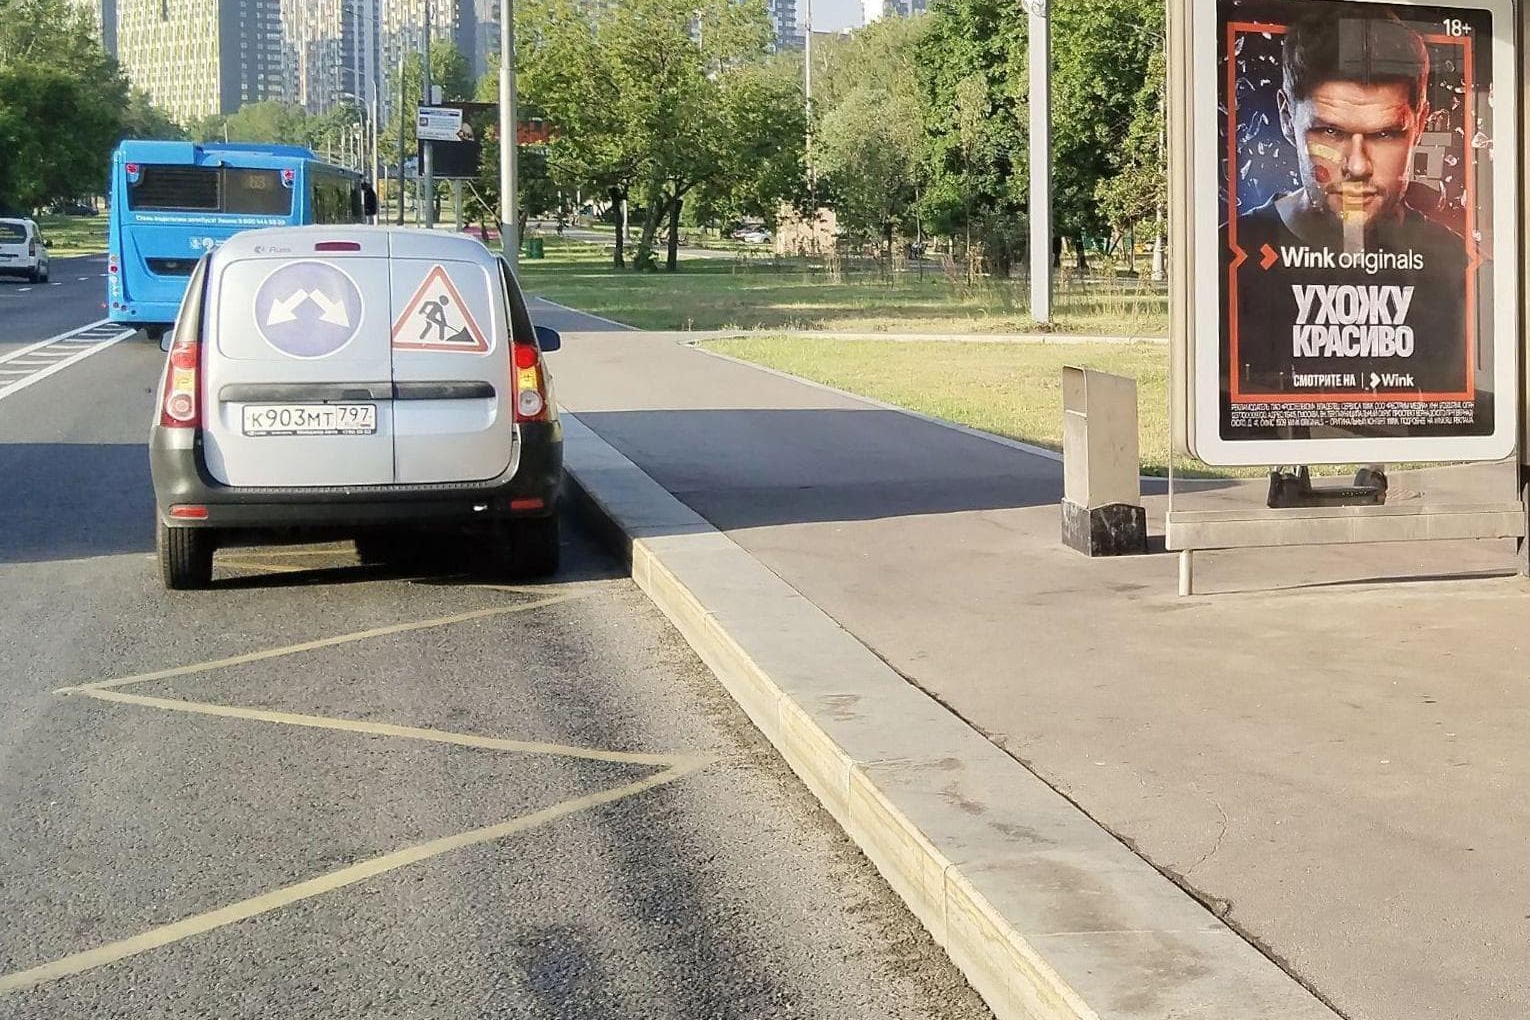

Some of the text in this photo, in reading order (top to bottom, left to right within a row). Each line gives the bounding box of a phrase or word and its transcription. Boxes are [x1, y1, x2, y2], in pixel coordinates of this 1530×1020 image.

[1442, 18, 1472, 37] 18+
[1280, 245, 1424, 275] Wink originals
[1291, 284, 1415, 325] УХОЖУ
[1292, 325, 1415, 358] КРАСИВО
[1293, 373, 1356, 387] СМОТРИТЕ НА
[1381, 373, 1415, 388] Wink
[338, 407, 369, 422] 797
